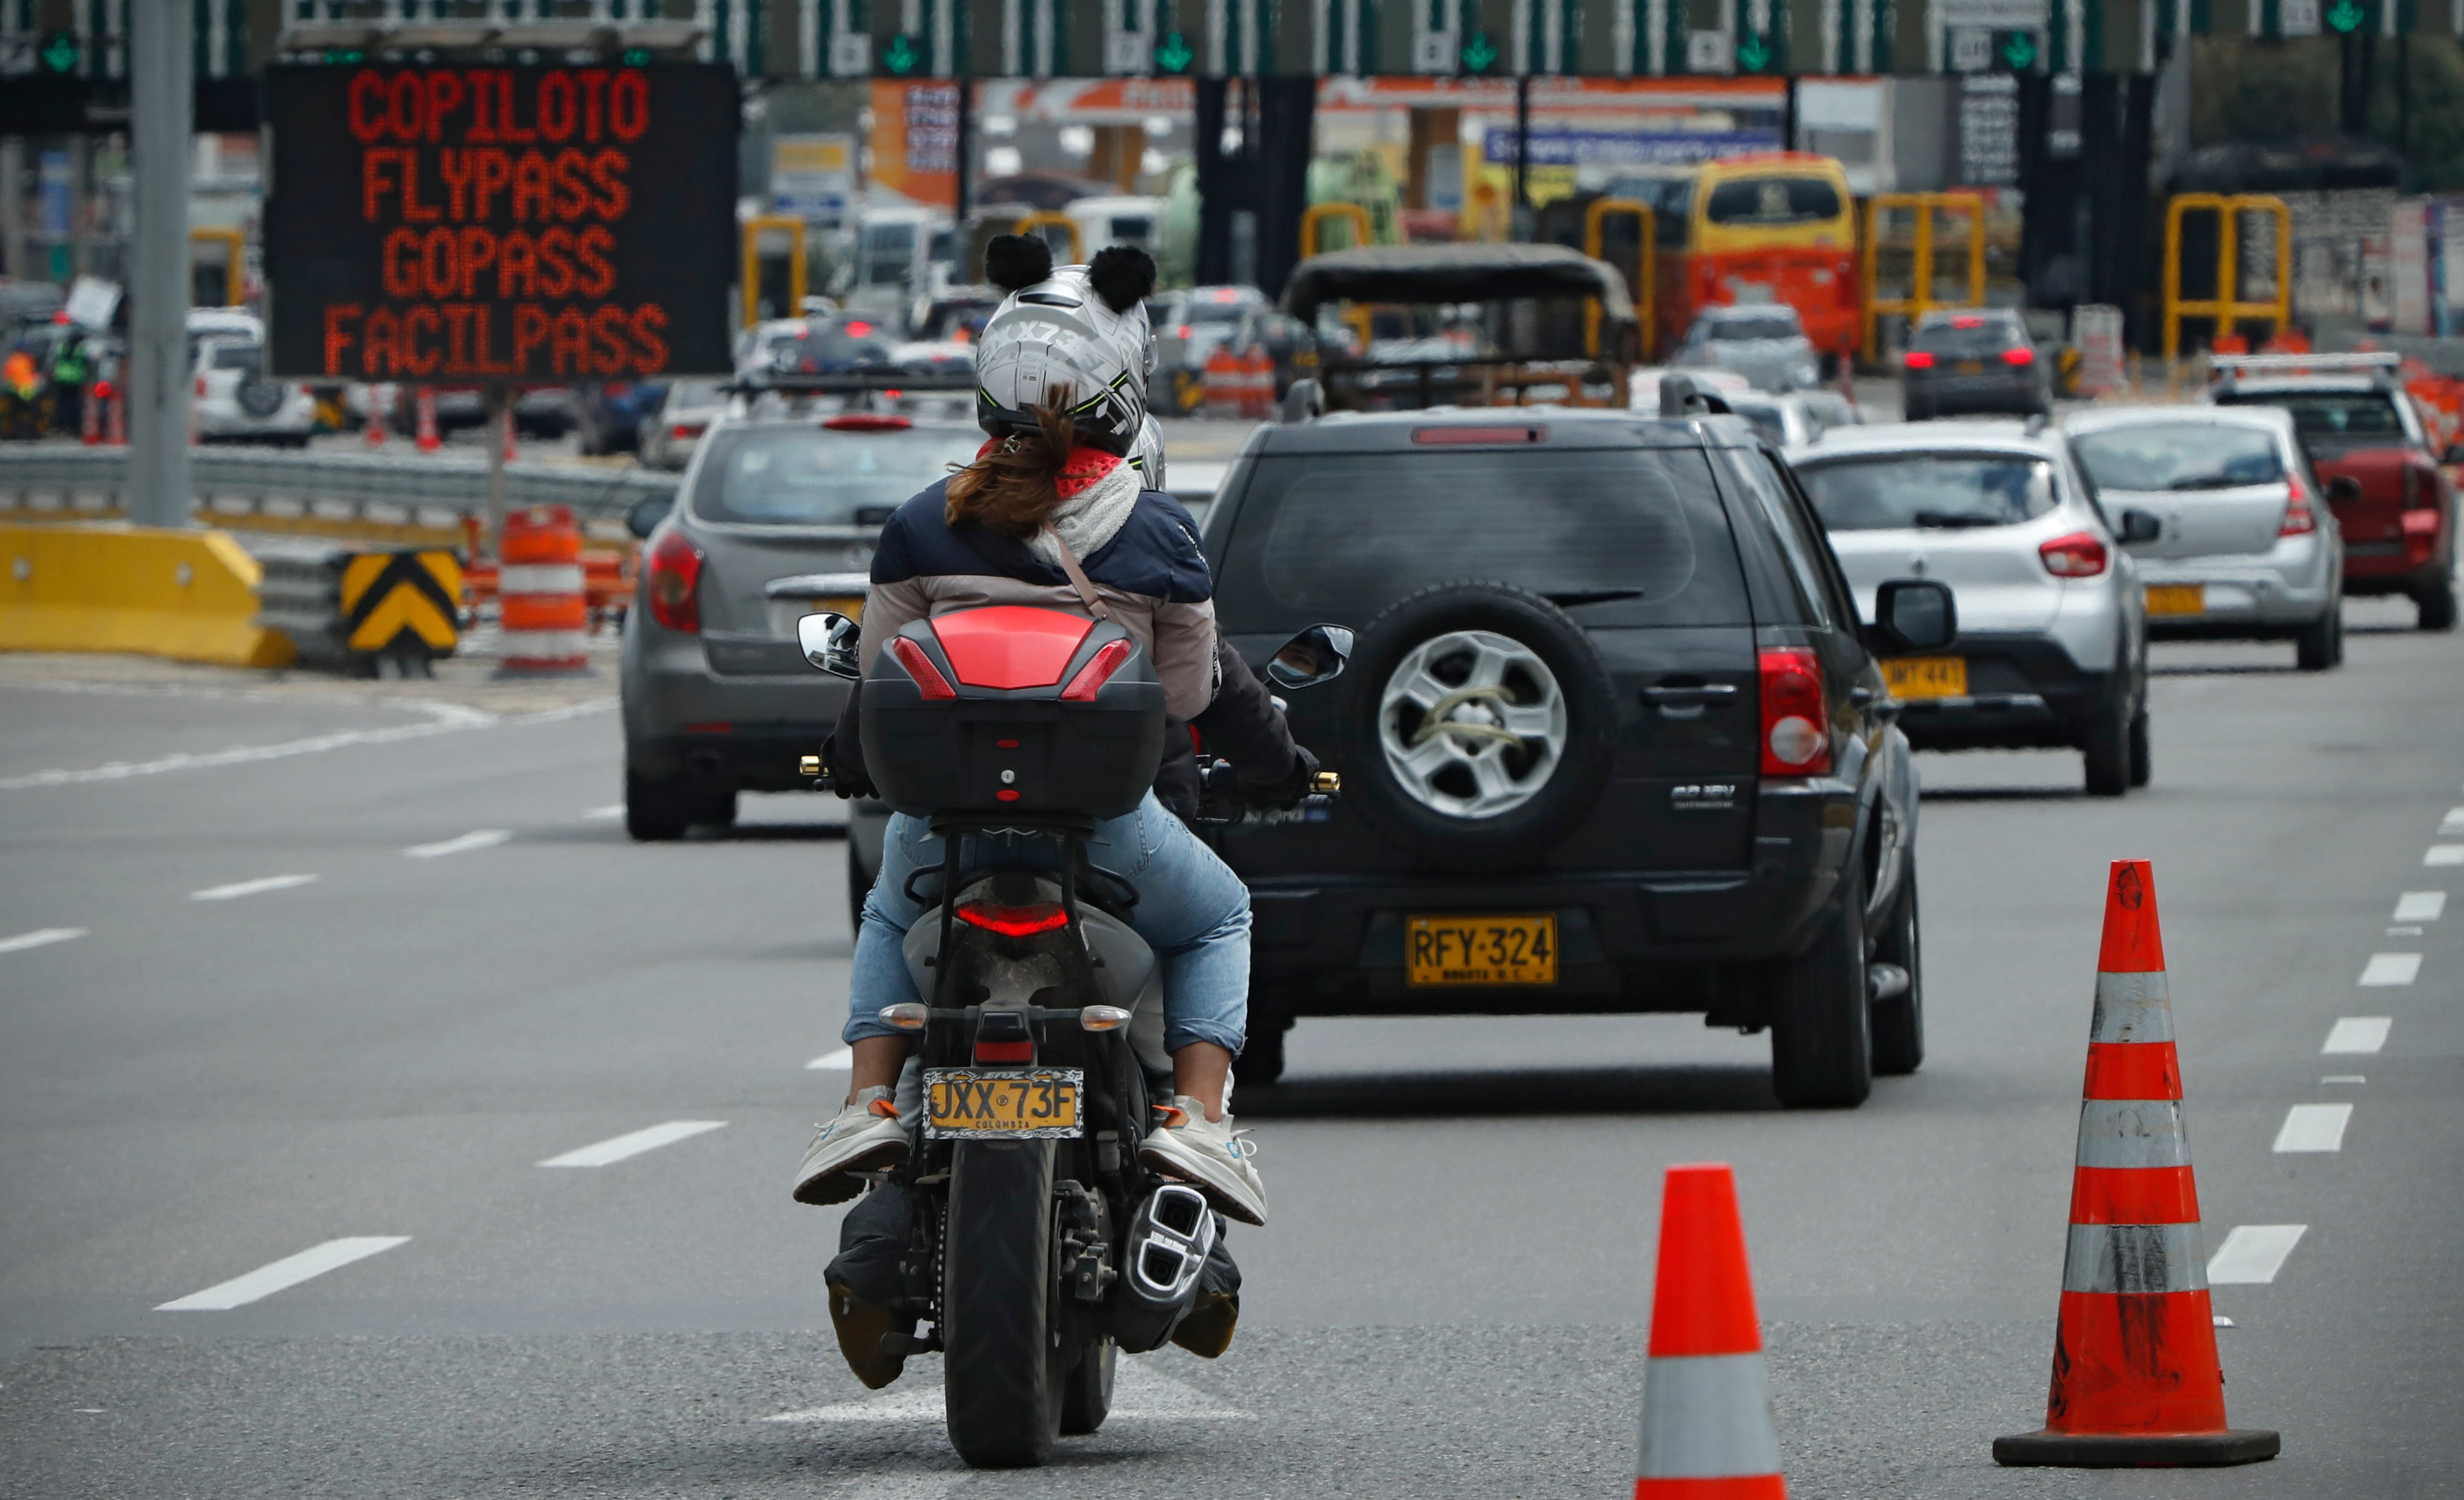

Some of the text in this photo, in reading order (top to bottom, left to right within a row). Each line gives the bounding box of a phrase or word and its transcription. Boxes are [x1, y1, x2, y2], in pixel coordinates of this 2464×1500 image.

[347, 69, 649, 143] COPILOTO
[363, 146, 631, 222] FLYPASS
[383, 225, 617, 299] GOPASS
[323, 302, 670, 377] FACILPASS
[1414, 927, 1550, 967] RFY 324
[930, 1081, 1076, 1119] JXX 73F
[975, 1120, 1031, 1129] COLOMBIA
